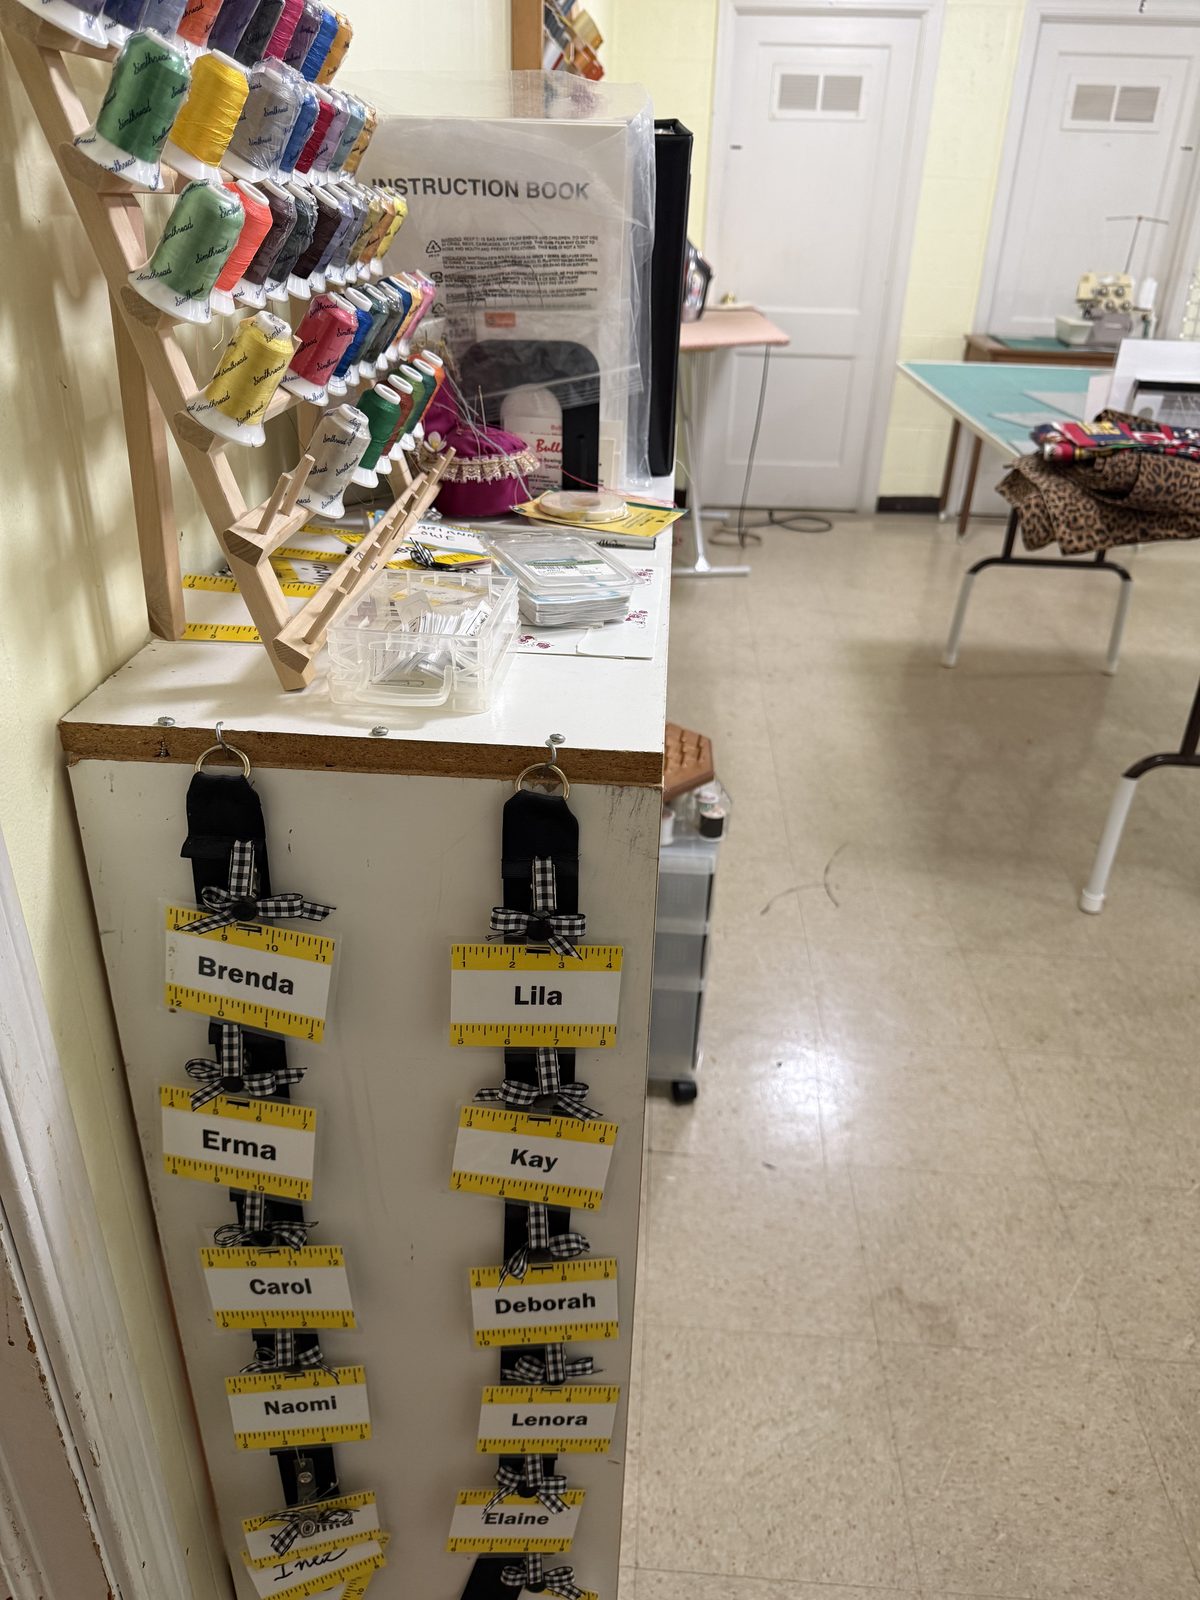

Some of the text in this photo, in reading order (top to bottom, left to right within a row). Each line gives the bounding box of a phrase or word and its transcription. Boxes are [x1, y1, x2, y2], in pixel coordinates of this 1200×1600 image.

[118, 99, 152, 131] Simthread
[526, 181, 590, 200] BOOK
[195, 239, 229, 264] Simthread
[136, 262, 173, 280] Simthread
[175, 283, 205, 307] Simthread
[220, 351, 248, 377] Simthread
[253, 359, 286, 387] Simthread
[195, 390, 231, 412] Simthread
[235, 401, 264, 427] Simthread
[536, 439, 562, 453] Bull
[221, 934, 228, 942] 9
[266, 943, 279, 952] 10
[315, 953, 326, 962] 11
[198, 955, 294, 995] Brenda
[508, 961, 516, 969] 2
[558, 961, 565, 969] 3
[514, 985, 563, 1006] Lila
[170, 999, 182, 1007] 12
[307, 1032, 314, 1040] 2
[504, 1038, 511, 1046] 6
[302, 1122, 308, 1130] 7
[202, 1128, 277, 1161] Erma
[510, 1148, 559, 1173] Kay
[253, 1184, 265, 1192] 10
[297, 1192, 307, 1200] 11
[583, 1201, 595, 1209] 10
[249, 1277, 312, 1296] Carol
[494, 1292, 596, 1315] Deborah
[264, 1395, 337, 1416] Naomi
[511, 1412, 588, 1427] Lenora
[484, 1512, 549, 1526] Elaine
